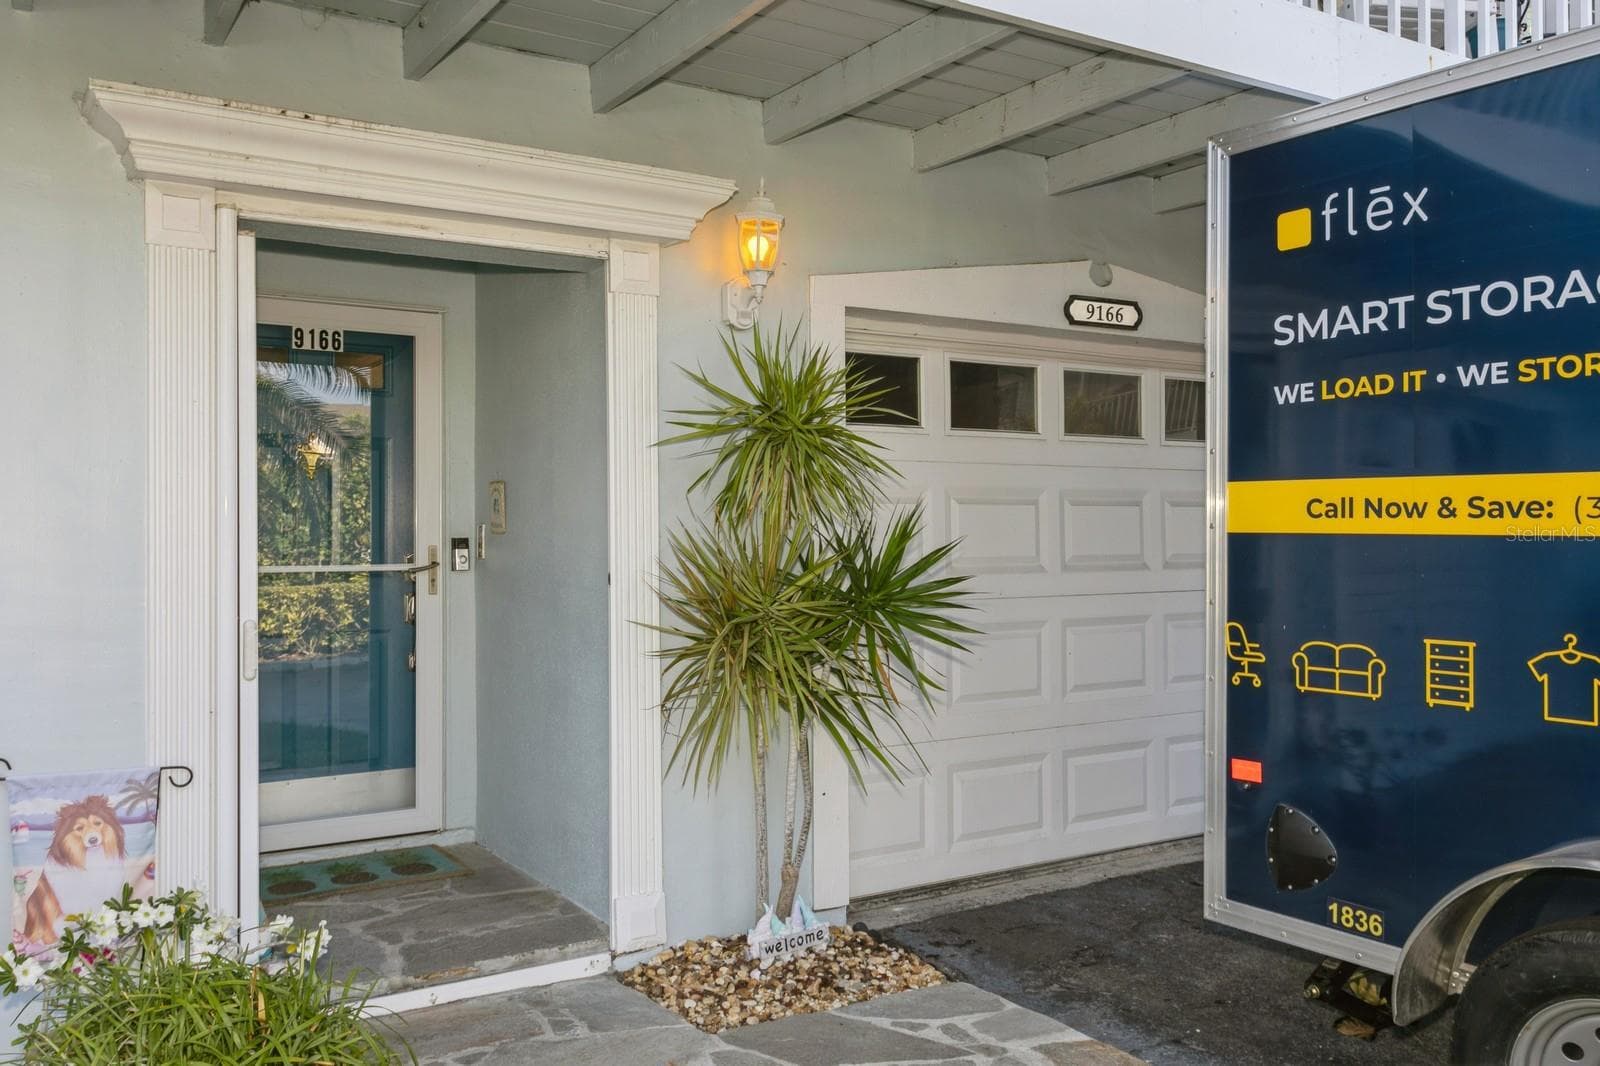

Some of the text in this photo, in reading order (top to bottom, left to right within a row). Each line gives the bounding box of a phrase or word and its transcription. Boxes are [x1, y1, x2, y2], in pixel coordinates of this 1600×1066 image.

[1086, 303, 1124, 323] 9166
[1273, 268, 1600, 346] SMART STORA
[294, 327, 342, 351] 9166
[1274, 352, 1600, 405] WE LOAD IT WE STOR
[1306, 497, 1354, 519] Call
[1364, 497, 1428, 519] Now
[1437, 496, 1457, 519] &
[1467, 496, 1554, 519] Save:
[1328, 902, 1383, 937] 1836
[764, 929, 824, 955] welcome
